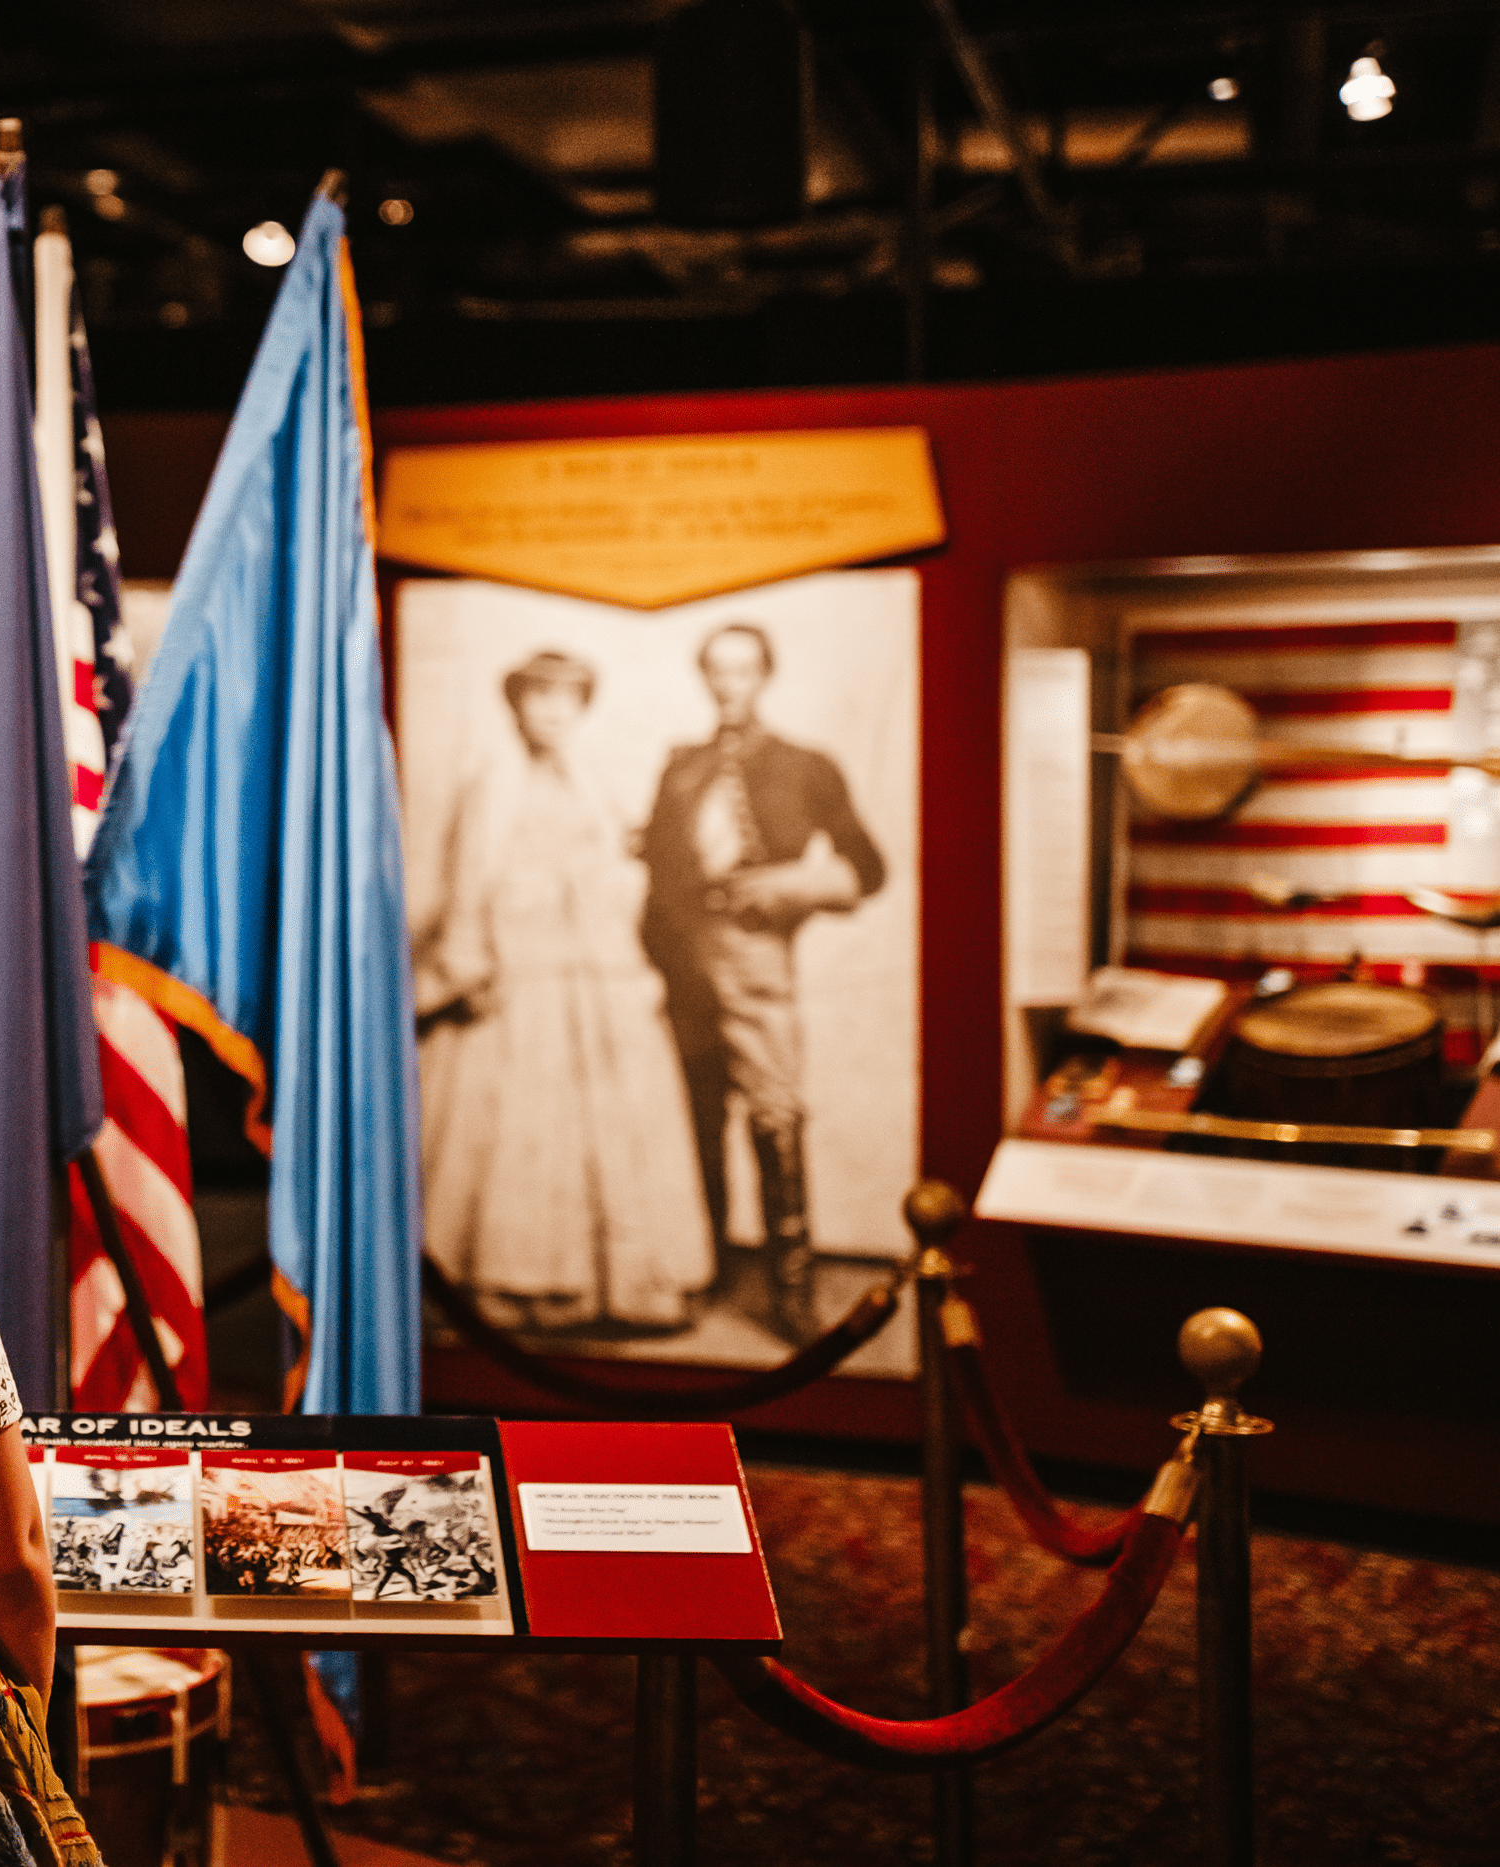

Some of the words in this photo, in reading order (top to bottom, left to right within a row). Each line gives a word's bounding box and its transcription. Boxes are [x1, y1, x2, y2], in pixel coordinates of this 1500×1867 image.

[19, 1416, 61, 1434] AR
[71, 1417, 118, 1435] OF
[129, 1419, 252, 1437] IDEALS
